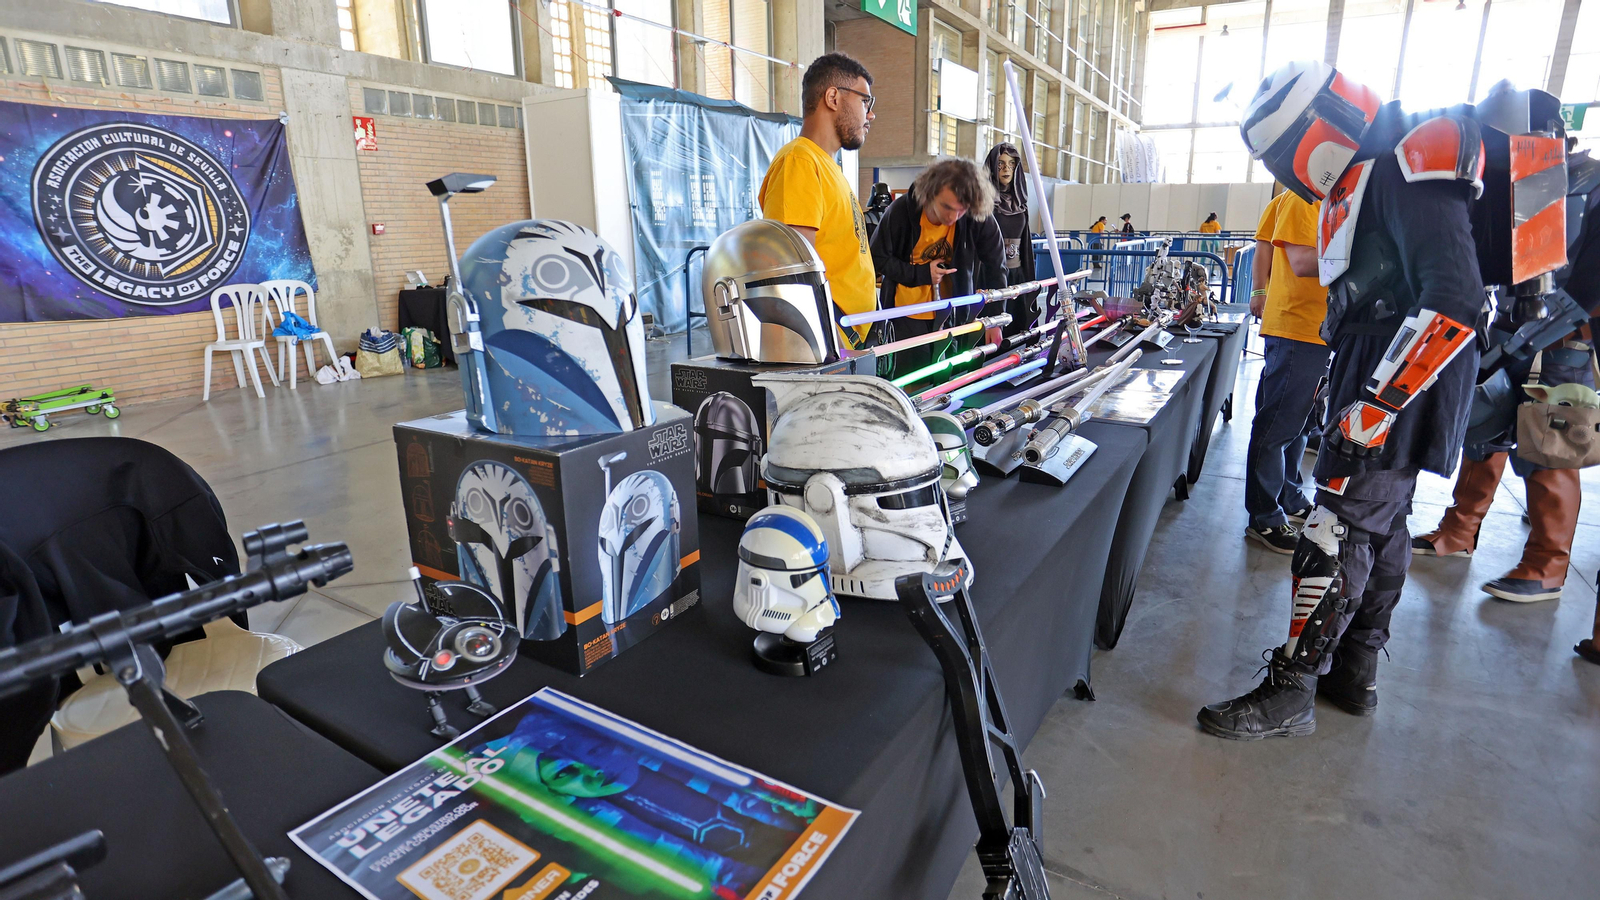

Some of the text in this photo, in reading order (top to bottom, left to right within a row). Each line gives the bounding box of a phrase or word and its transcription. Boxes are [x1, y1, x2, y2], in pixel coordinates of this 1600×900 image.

[46, 131, 227, 191] ASOCIACION CULTURAL DE SEVILLA
[67, 239, 241, 299] THE LEGACY OF FORCE
[675, 368, 707, 380] STAR
[675, 378, 708, 390] WARS
[648, 423, 687, 447] STAR
[648, 435, 688, 460] WARS
[583, 621, 627, 651] BO-KATAN KRYZE
[335, 745, 508, 848] ÚNETE AL
[387, 793, 403, 804] THE
[404, 772, 436, 793] LEGACY
[437, 765, 448, 773] OF
[348, 758, 506, 860] LEGADO
[412, 801, 479, 847] COLABORADOR
[369, 837, 414, 869] ESCANEA
[413, 811, 454, 841] NUESTRO
[771, 830, 829, 888] FORCE
